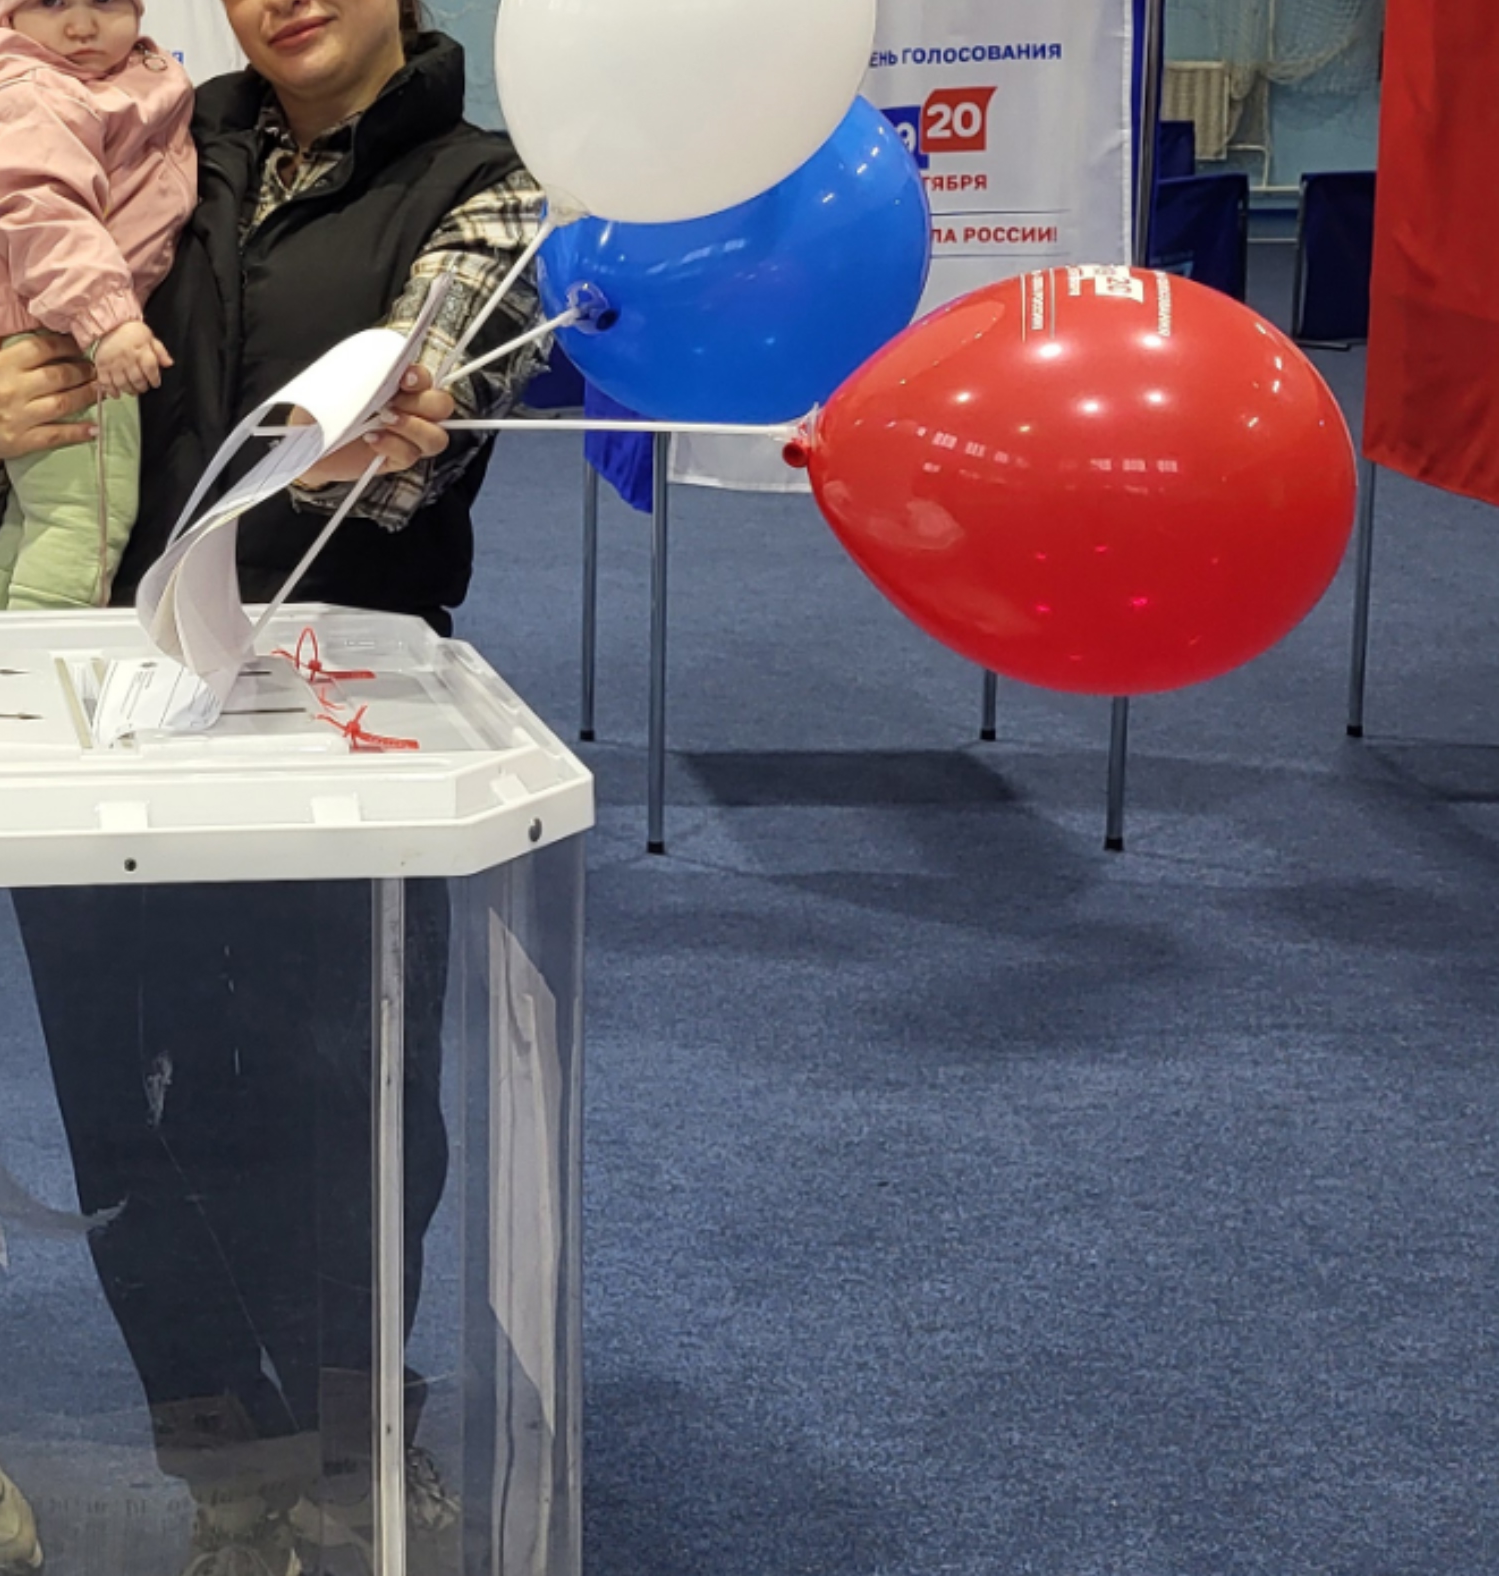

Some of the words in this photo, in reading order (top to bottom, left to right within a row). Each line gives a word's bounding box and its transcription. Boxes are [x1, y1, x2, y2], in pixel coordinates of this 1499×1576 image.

[868, 50, 898, 68] ЕНЬ
[902, 43, 1062, 65] ГОЛОСОВАНИЯ
[894, 121, 917, 155] 9
[926, 101, 983, 139] 20
[922, 174, 988, 191] ТЯБРЯ
[930, 228, 958, 244] ЛА
[963, 226, 1058, 244] РОССИИ!
